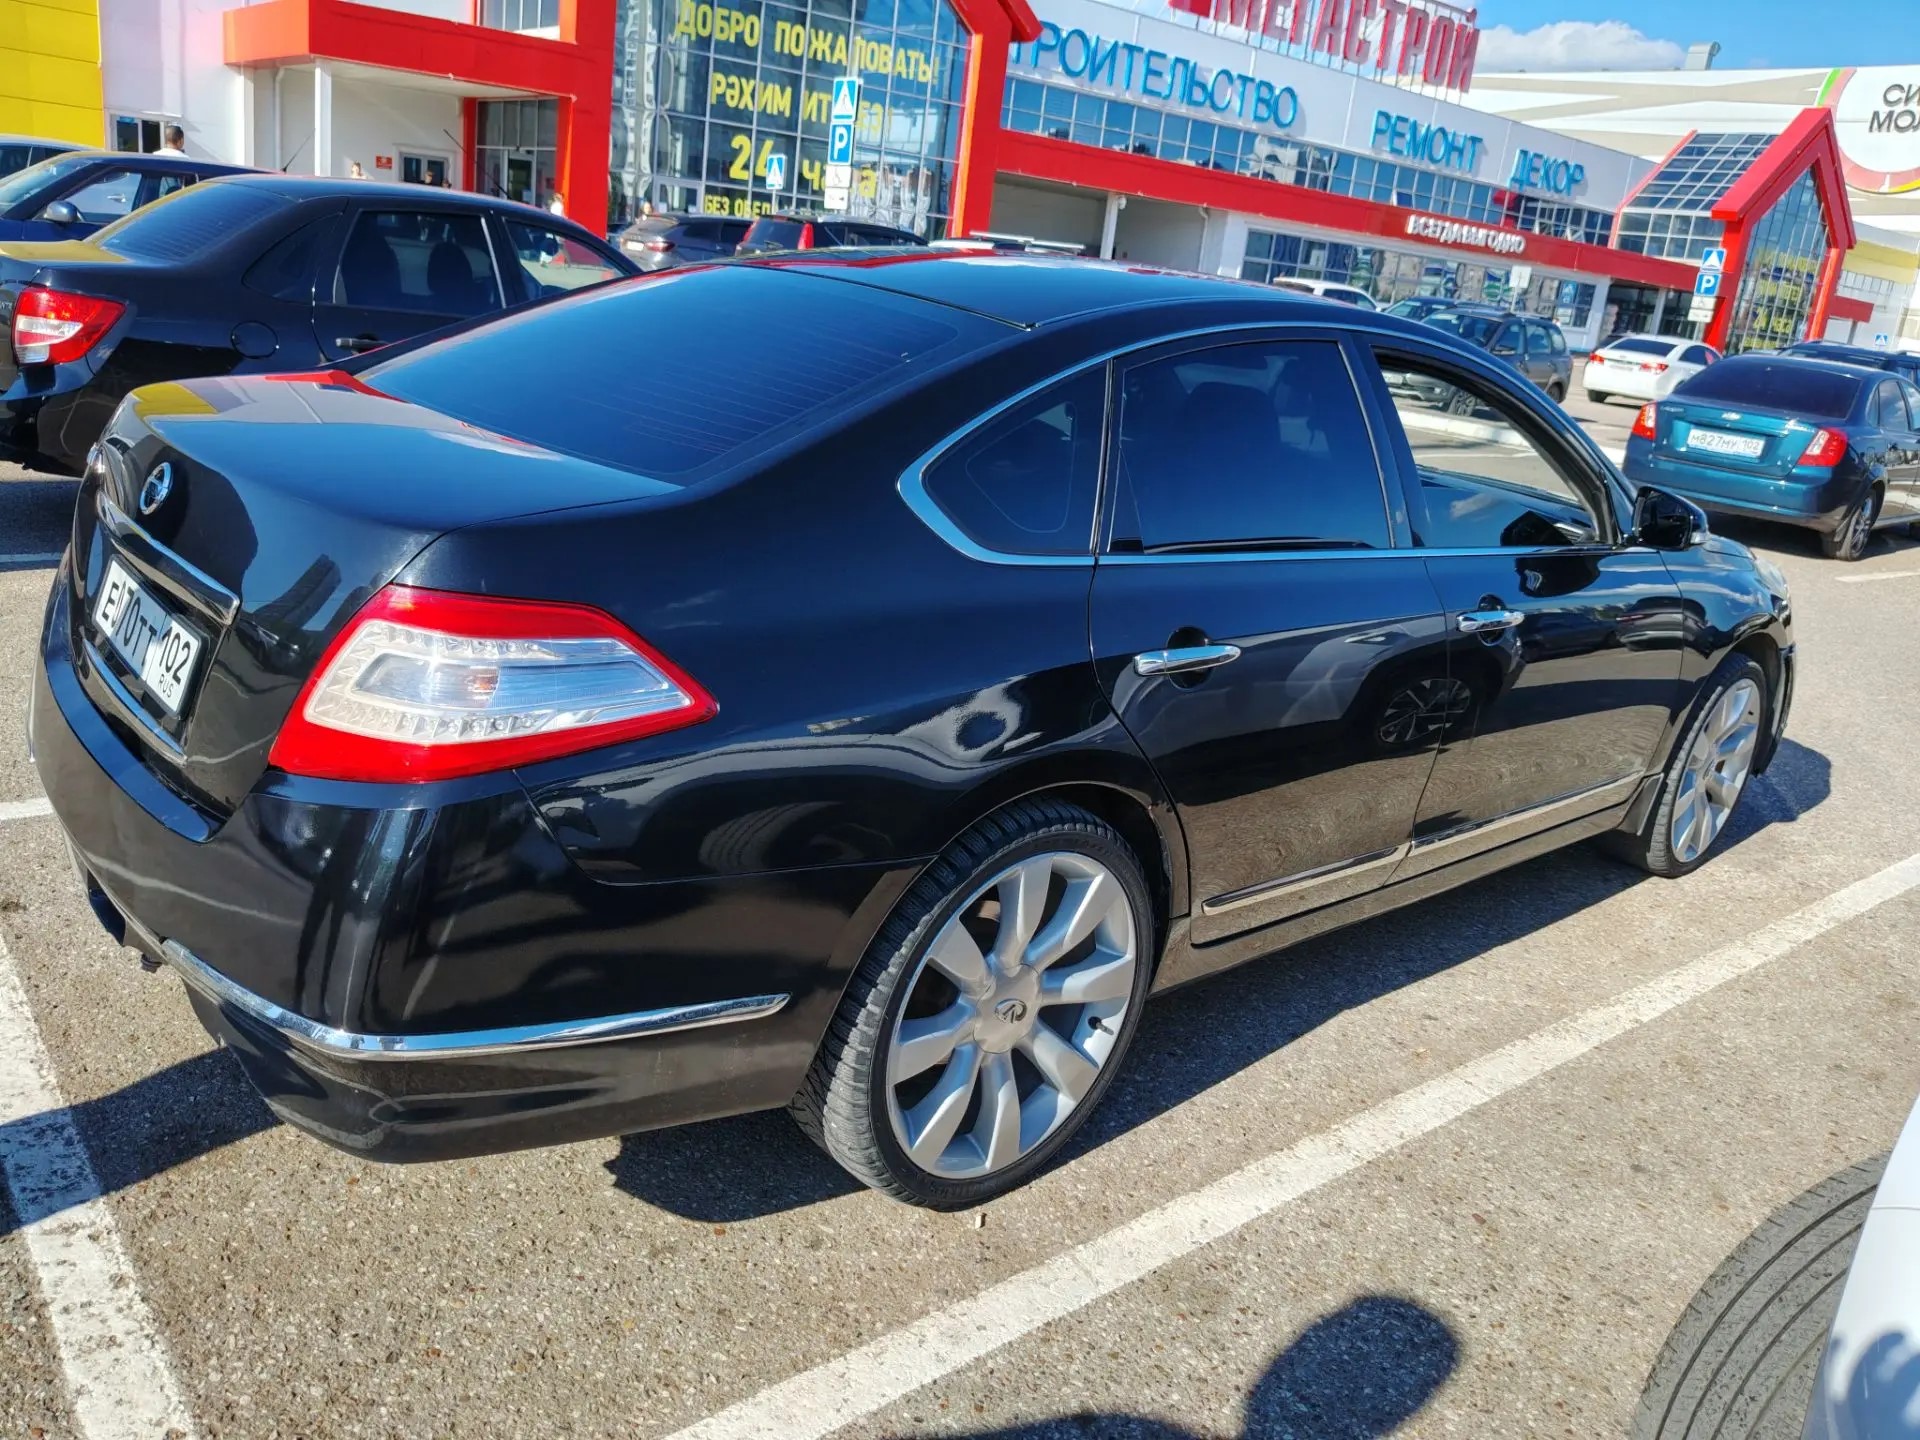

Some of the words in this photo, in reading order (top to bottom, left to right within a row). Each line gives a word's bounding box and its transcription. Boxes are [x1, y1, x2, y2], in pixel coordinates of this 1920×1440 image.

[675, 0, 760, 47] ДОБРО
[774, 20, 939, 85] ПОЖАЛОВАТЬ!
[833, 126, 848, 160] P
[1369, 109, 1483, 173] РЕМОНТ
[1506, 148, 1585, 196] ДЕКОР
[1700, 274, 1716, 294] P
[159, 625, 191, 687] 102
[158, 673, 174, 699] RUS
